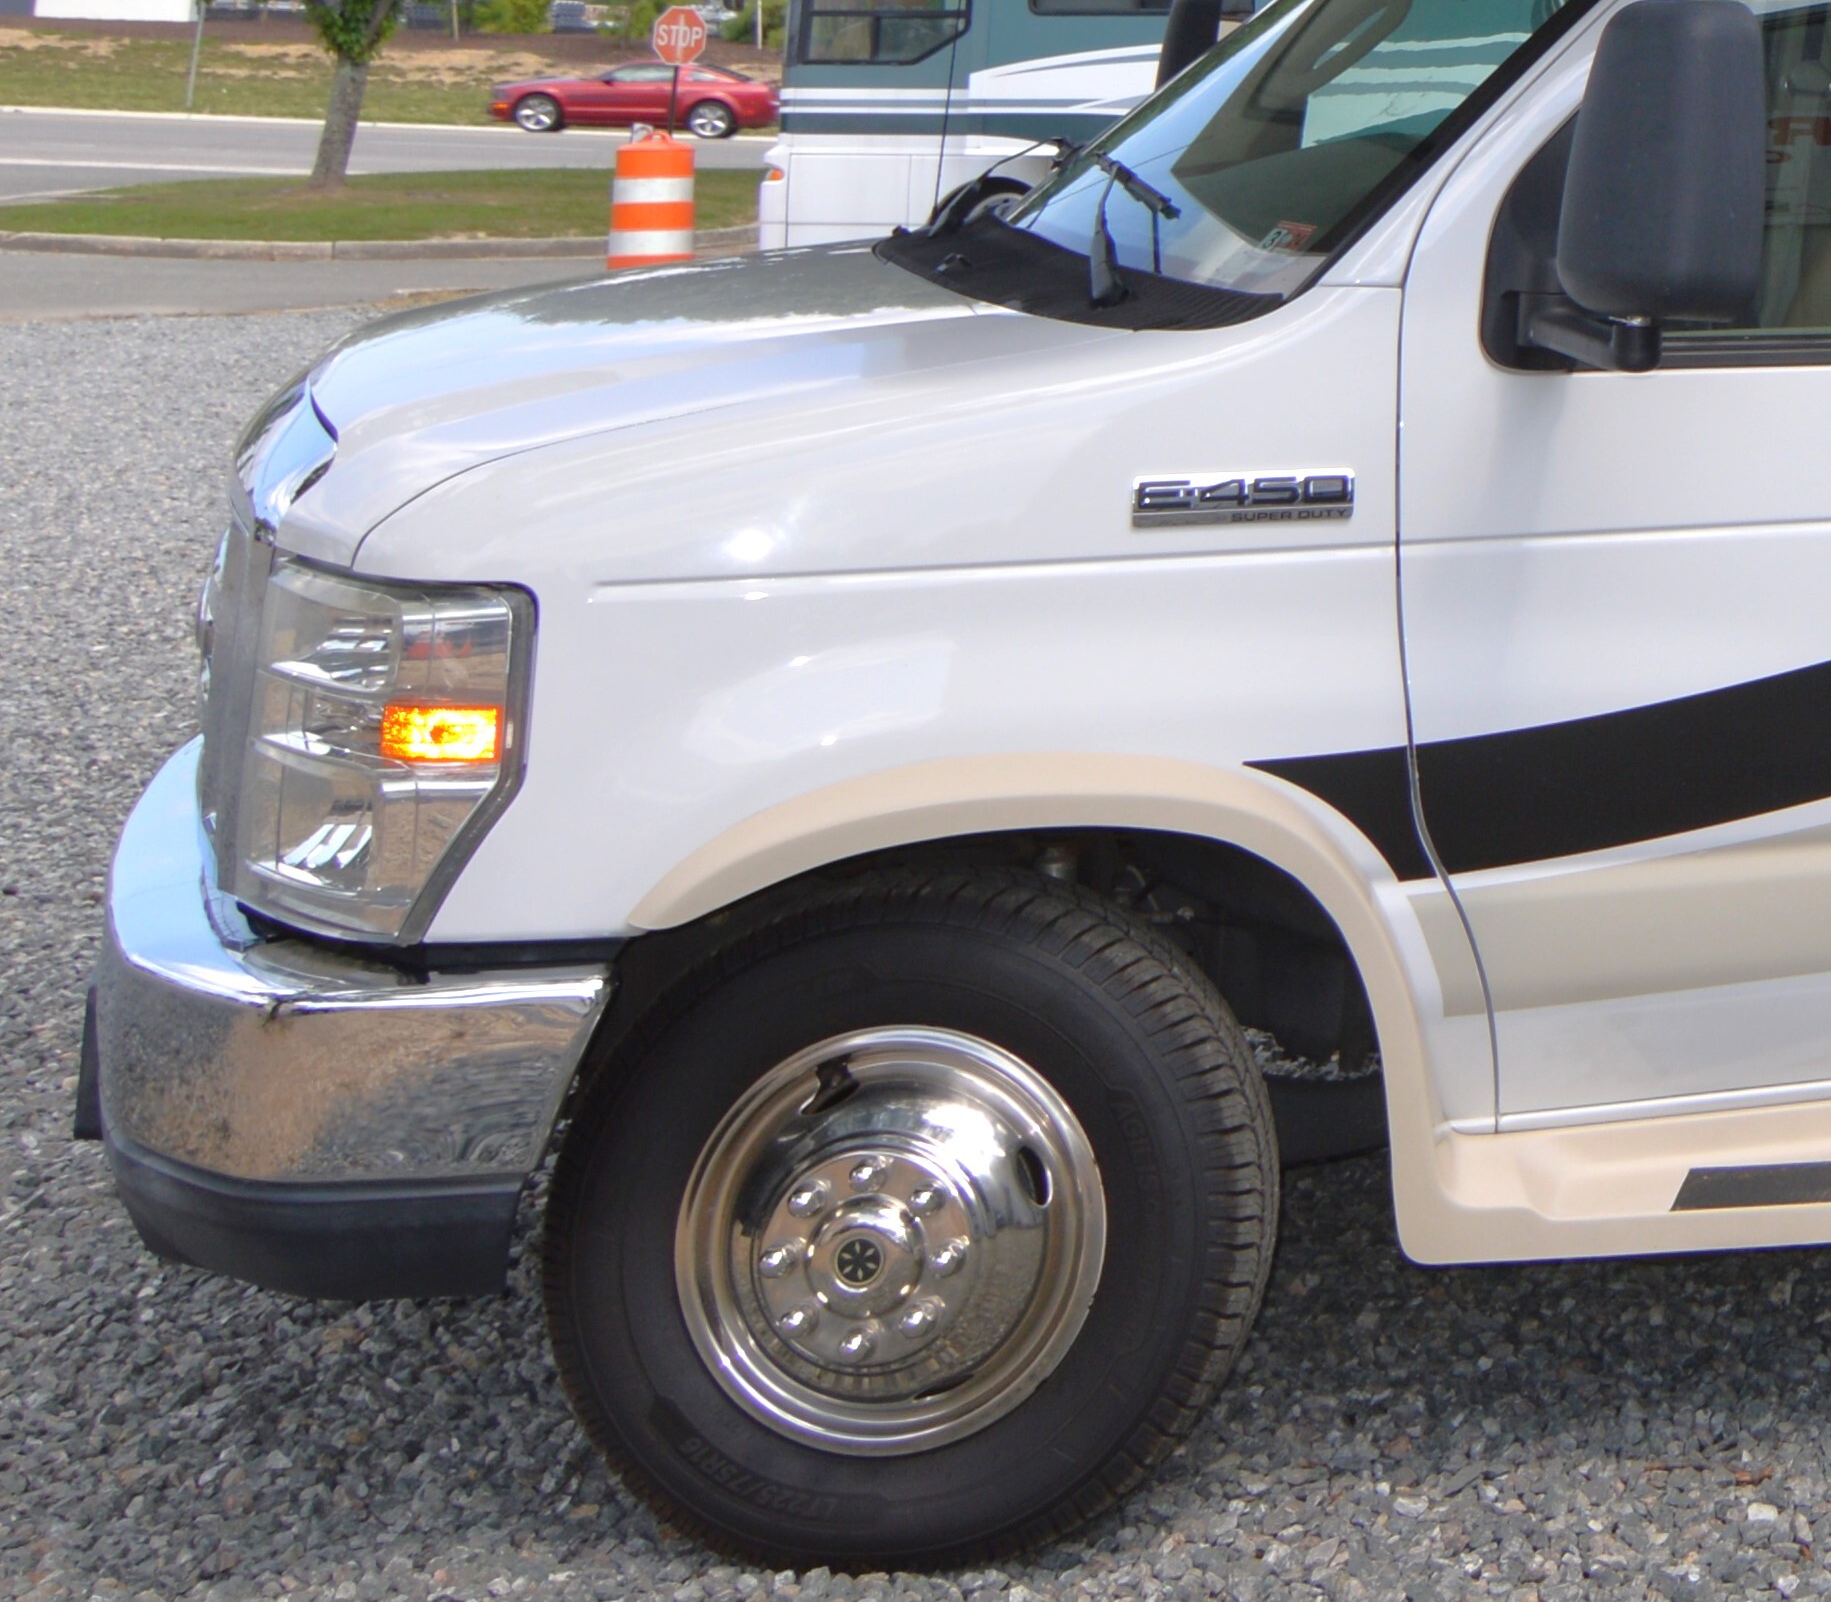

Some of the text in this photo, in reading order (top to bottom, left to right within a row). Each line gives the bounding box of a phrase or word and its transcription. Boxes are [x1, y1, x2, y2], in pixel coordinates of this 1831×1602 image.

[657, 24, 702, 48] STOP
[1136, 472, 1352, 510] E-450
[1231, 508, 1347, 523] SUPER DUTY
